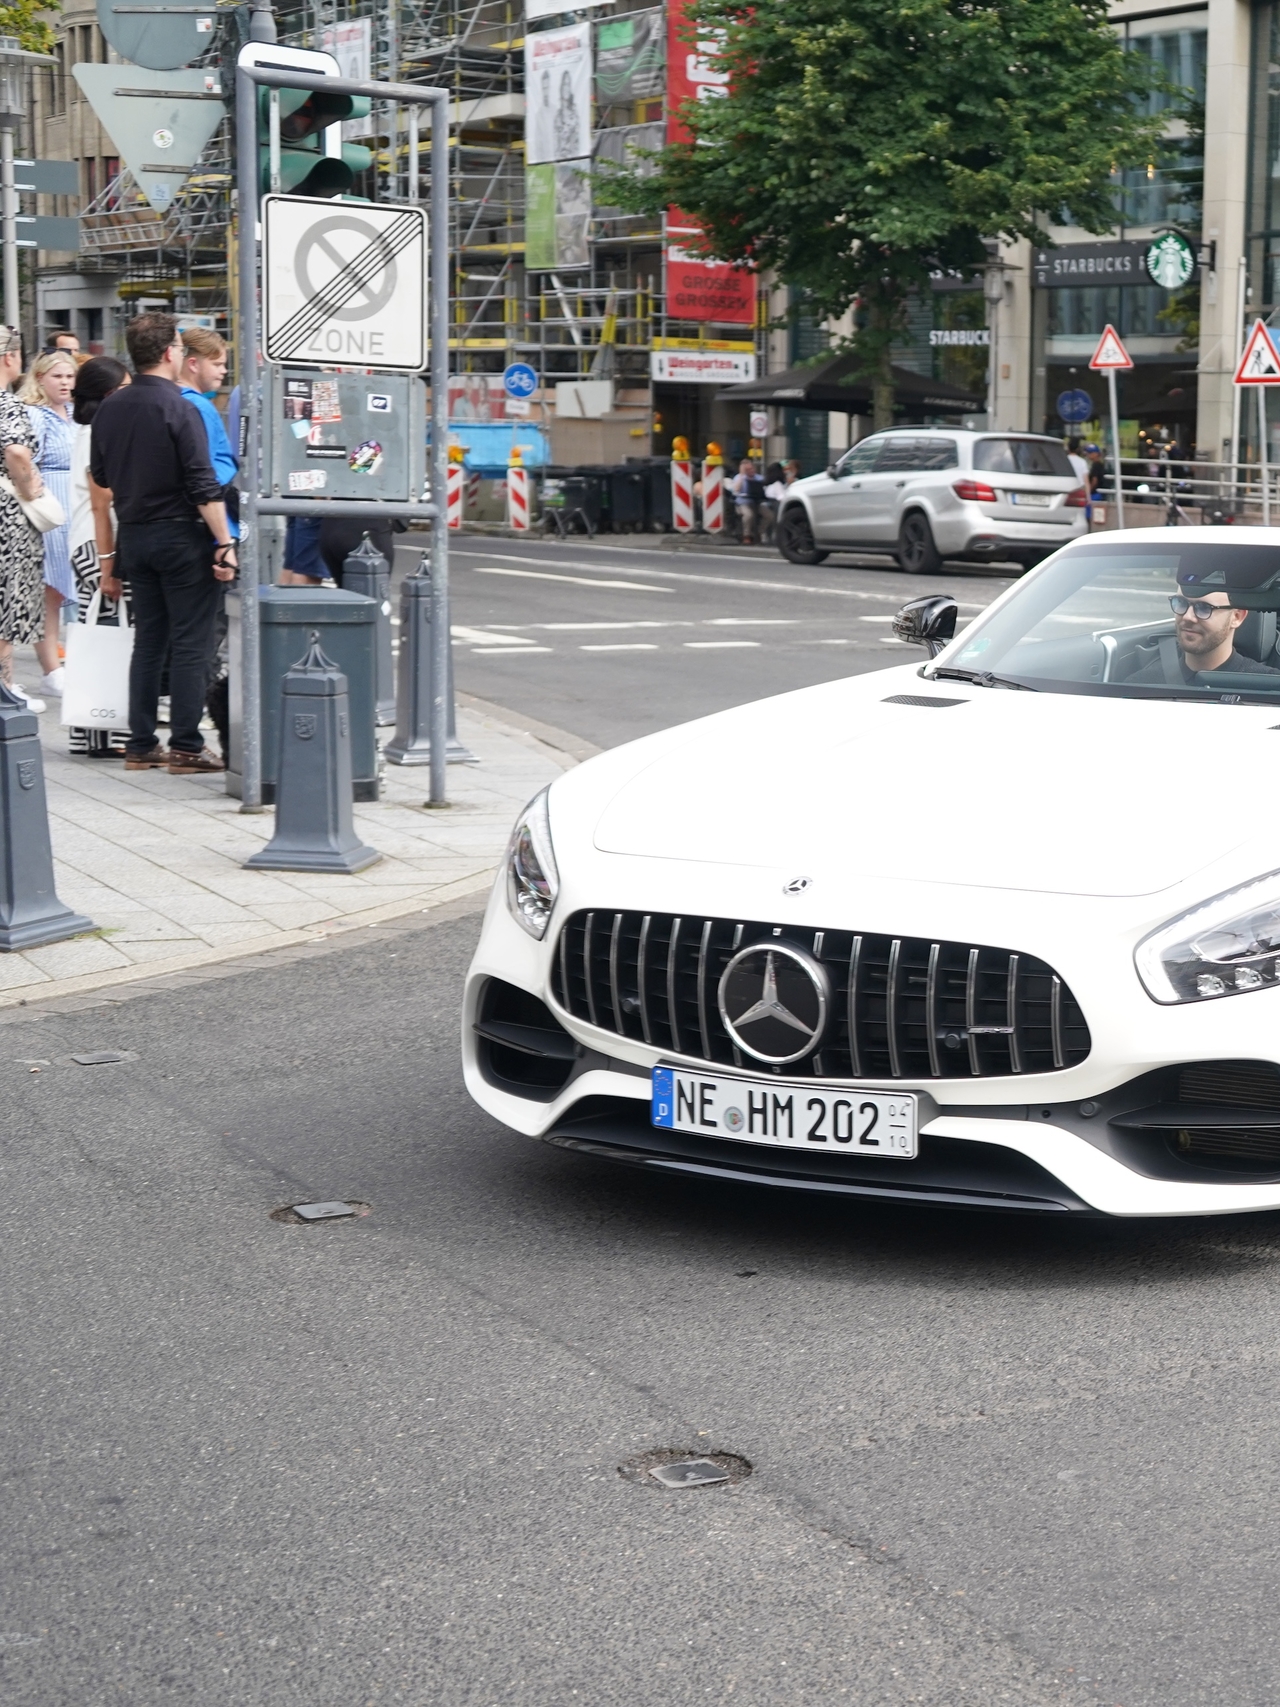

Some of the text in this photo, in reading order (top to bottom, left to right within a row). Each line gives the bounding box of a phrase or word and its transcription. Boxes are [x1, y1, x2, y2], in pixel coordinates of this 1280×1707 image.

[1053, 256, 1132, 274] STARBUCKS
[308, 327, 385, 356] ZONE
[90, 708, 117, 719] COS
[658, 1103, 669, 1117] D
[676, 1078, 880, 1146] NE HM 202
[888, 1103, 908, 1118] 04
[889, 1134, 907, 1149] 10
